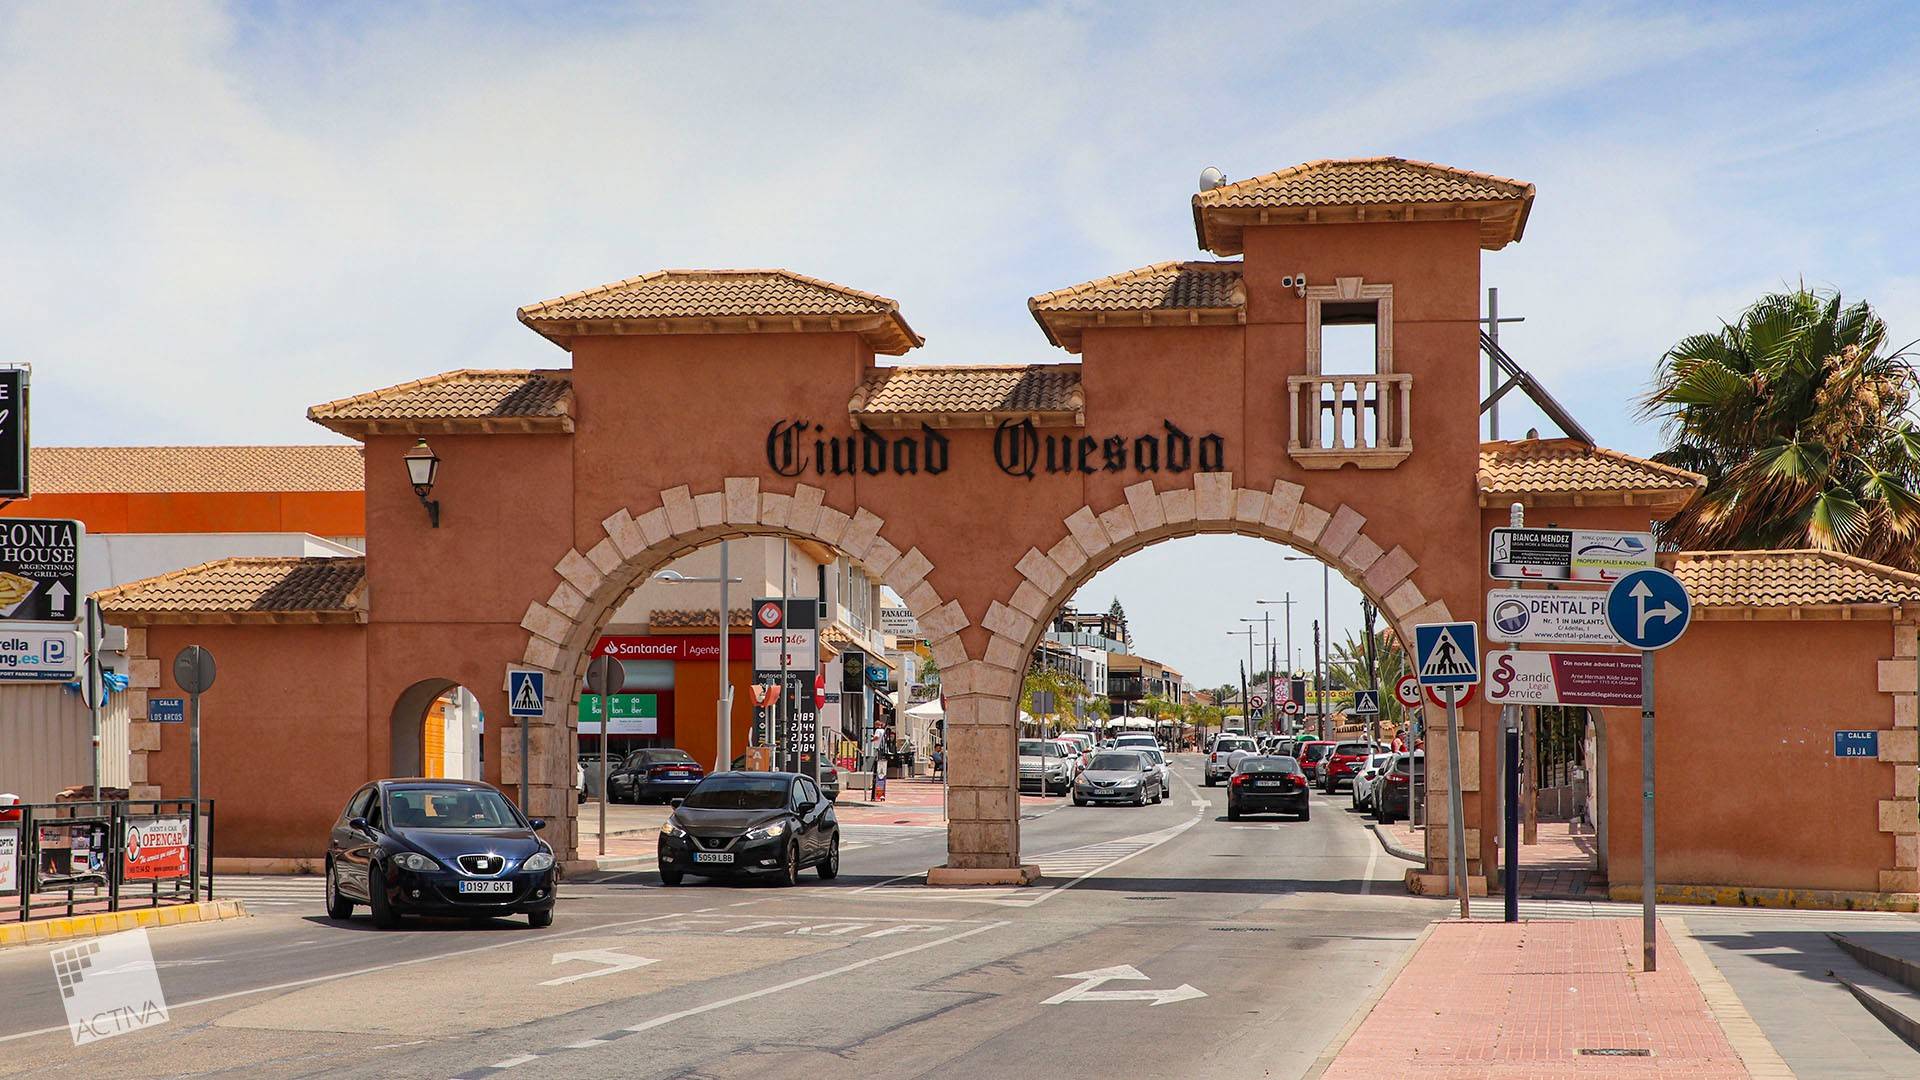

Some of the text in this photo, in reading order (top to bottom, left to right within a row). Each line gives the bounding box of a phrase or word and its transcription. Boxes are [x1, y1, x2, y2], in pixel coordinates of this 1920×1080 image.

[766, 417, 1225, 481] Ciudad Quesada
[1512, 533, 1570, 543] BIANCA MENDEZ
[3, 547, 75, 563] HOUSE
[19, 563, 74, 571] ARGENTINIAN
[1531, 600, 1587, 614] DENTAL
[1534, 631, 1613, 640] www.dental-planet.eu
[620, 643, 720, 656] Santander Agente
[1403, 686, 1419, 696] 30
[1529, 682, 1549, 691] Legal
[1846, 747, 1866, 755] BAJA
[142, 832, 184, 847] OPENCAR
[467, 882, 510, 891] 0197 GKT
